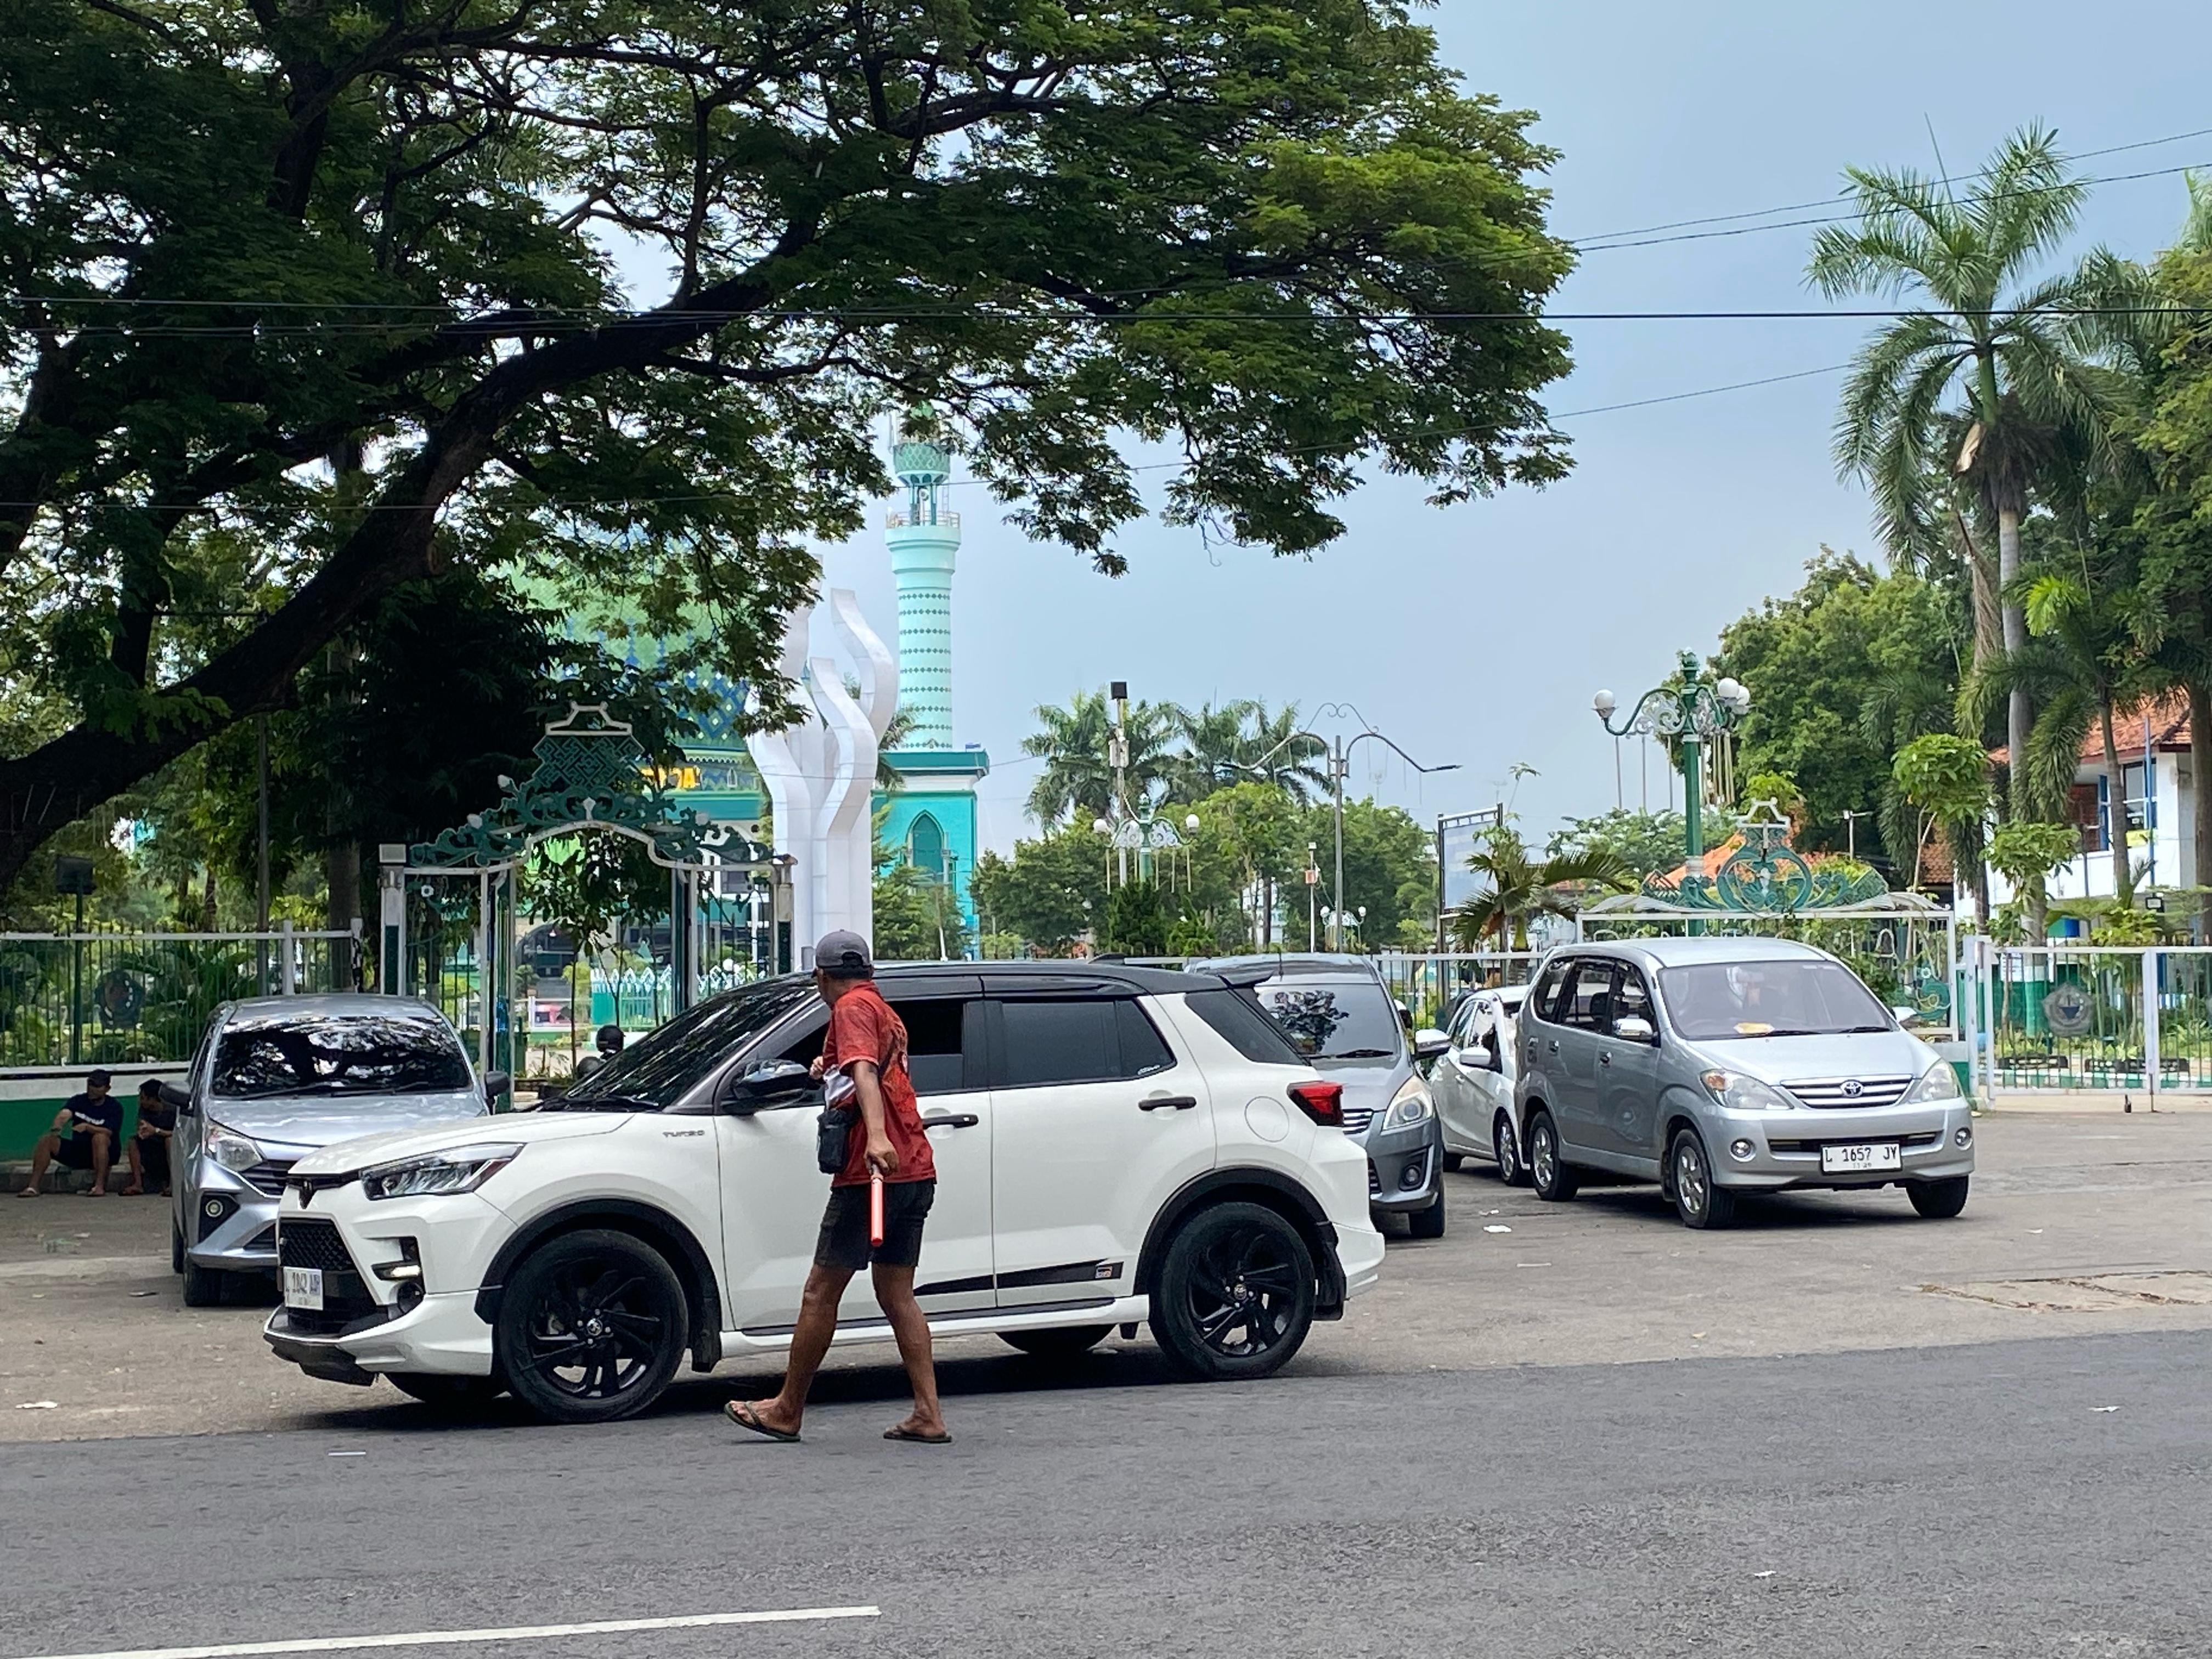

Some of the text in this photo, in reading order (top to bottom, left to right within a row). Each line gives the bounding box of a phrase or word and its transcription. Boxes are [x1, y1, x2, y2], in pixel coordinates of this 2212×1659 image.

[1825, 1146, 1897, 1162] L 1657 JY
